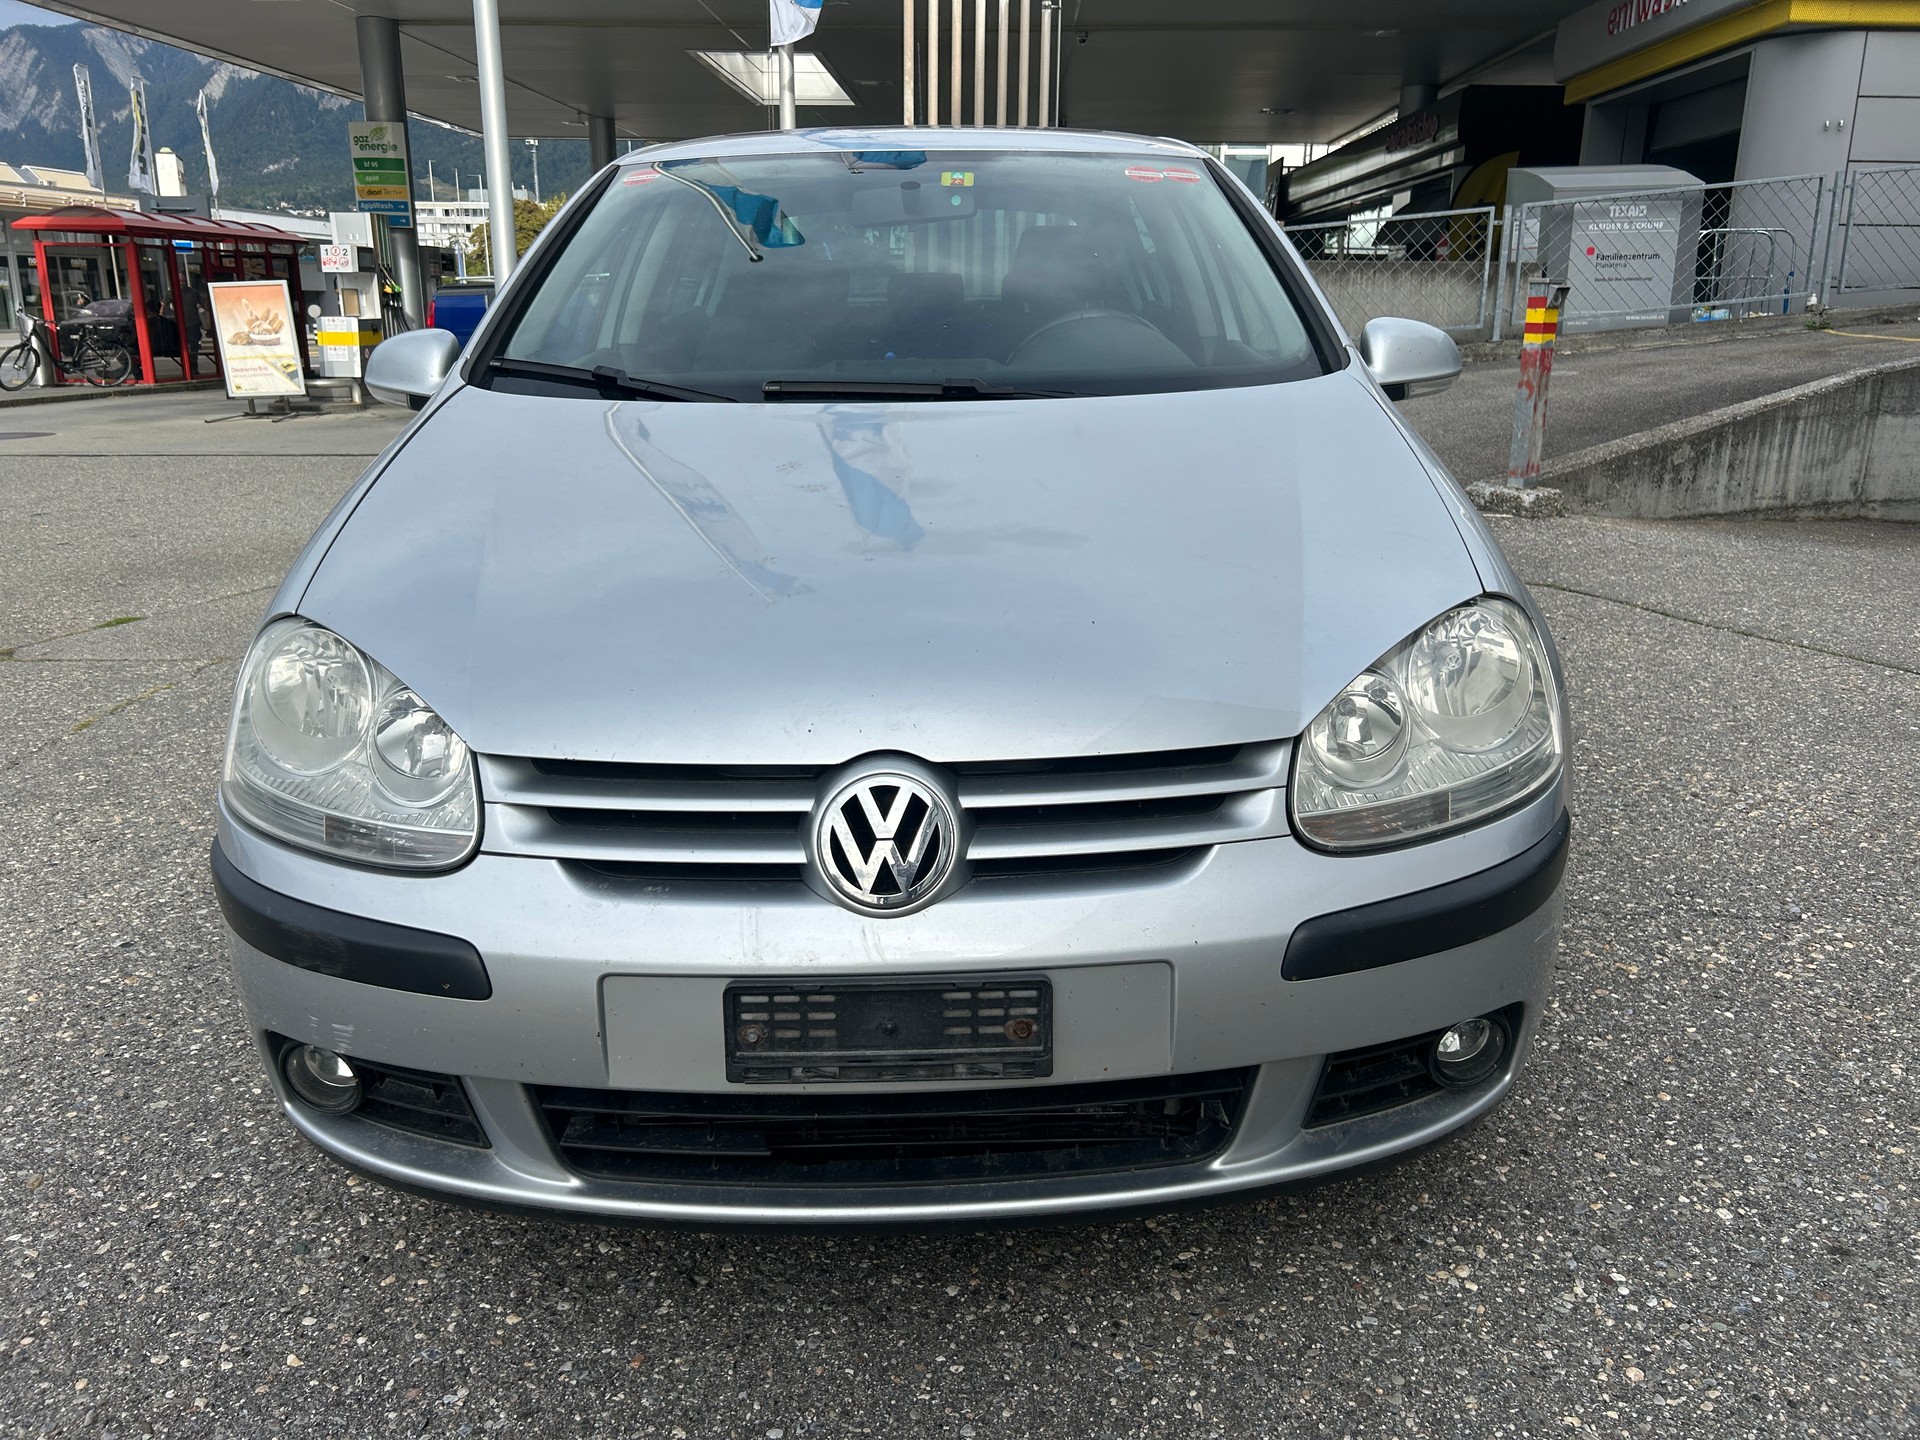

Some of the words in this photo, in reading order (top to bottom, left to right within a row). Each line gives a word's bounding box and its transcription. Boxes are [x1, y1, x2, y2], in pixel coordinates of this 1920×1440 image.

[1607, 0, 1634, 36] eni
[1637, 0, 1687, 22] wa
[353, 135, 369, 145] gaz
[359, 142, 398, 153] energie
[360, 202, 394, 211] AgipWash
[1608, 204, 1648, 218] TEXAID
[1588, 222, 1621, 231] KLEIDER
[1623, 222, 1630, 230] &
[324, 248, 329, 256] 1
[342, 248, 348, 256] 2
[1596, 252, 1660, 261] Familienzentrum
[820, 776, 953, 909] VW
